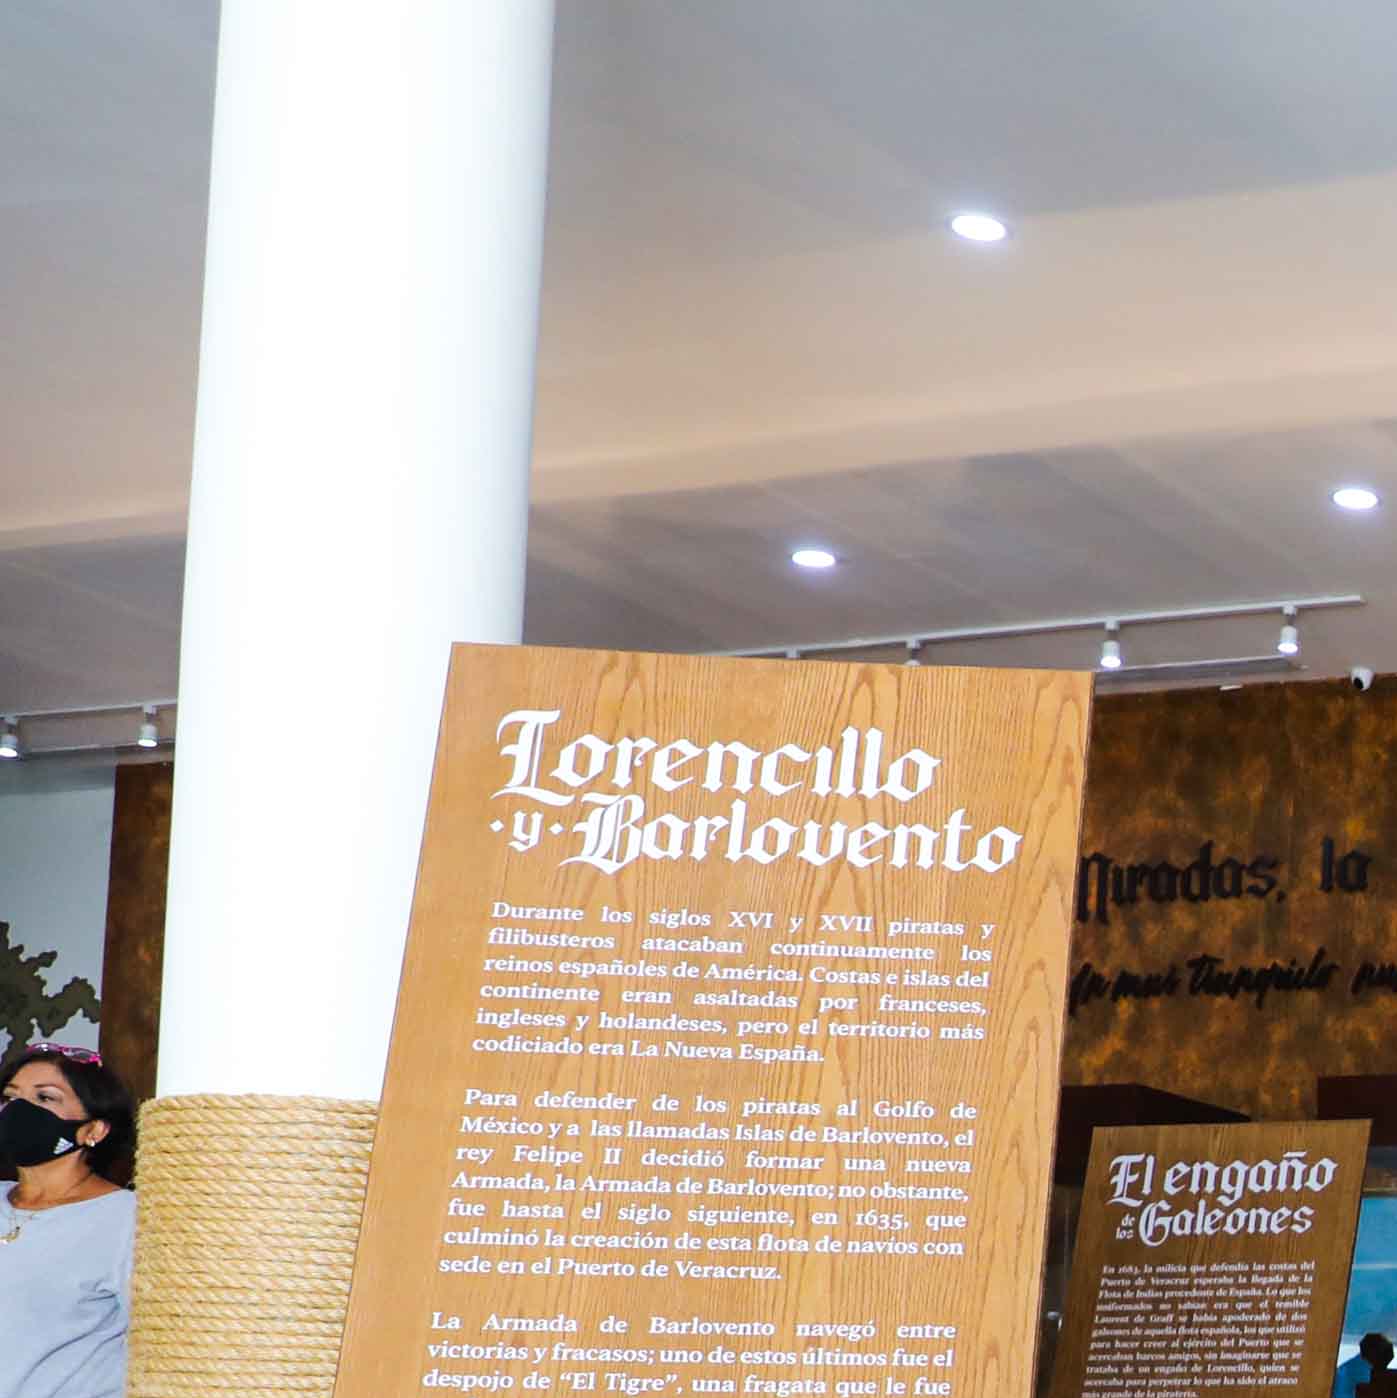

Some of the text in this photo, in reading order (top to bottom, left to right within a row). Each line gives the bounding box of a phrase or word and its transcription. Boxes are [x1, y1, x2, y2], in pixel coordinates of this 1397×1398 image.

[489, 708, 942, 807] Lorencillo
[559, 791, 1023, 875] Barlovento
[1320, 834, 1373, 893] la
[491, 901, 996, 940] Durante los siglos XVI y XVII piratas y
[487, 926, 993, 963] filibusteros atacaban continuamente los
[483, 954, 990, 989] reinos españoles de América. Costas e islas del
[479, 982, 987, 1017] continente eran asaltadas por franceses,
[475, 1007, 986, 1041] ingleses y holandeses, pero el territorio más
[471, 1034, 825, 1065] codiciado era La Nueva España.
[463, 1088, 977, 1121] Para defender de los piratas al Golfo de
[459, 1115, 976, 1149] México y a las llamadas Islas de Barlovento, el
[455, 1144, 972, 1174] rey Felipe II decidió formar una nueva
[450, 1171, 969, 1203] Armada, la Armada de Barlovento; no obstante,
[1106, 1150, 1339, 1207] El engaño
[447, 1197, 967, 1233] fue hasta el siglo siguiente, en 1635, que
[1138, 1199, 1315, 1247] Galeones
[443, 1226, 965, 1256] culminó la creación de esta flota de navíos con
[438, 1255, 782, 1280] sede en el Puerto de Veracruz.
